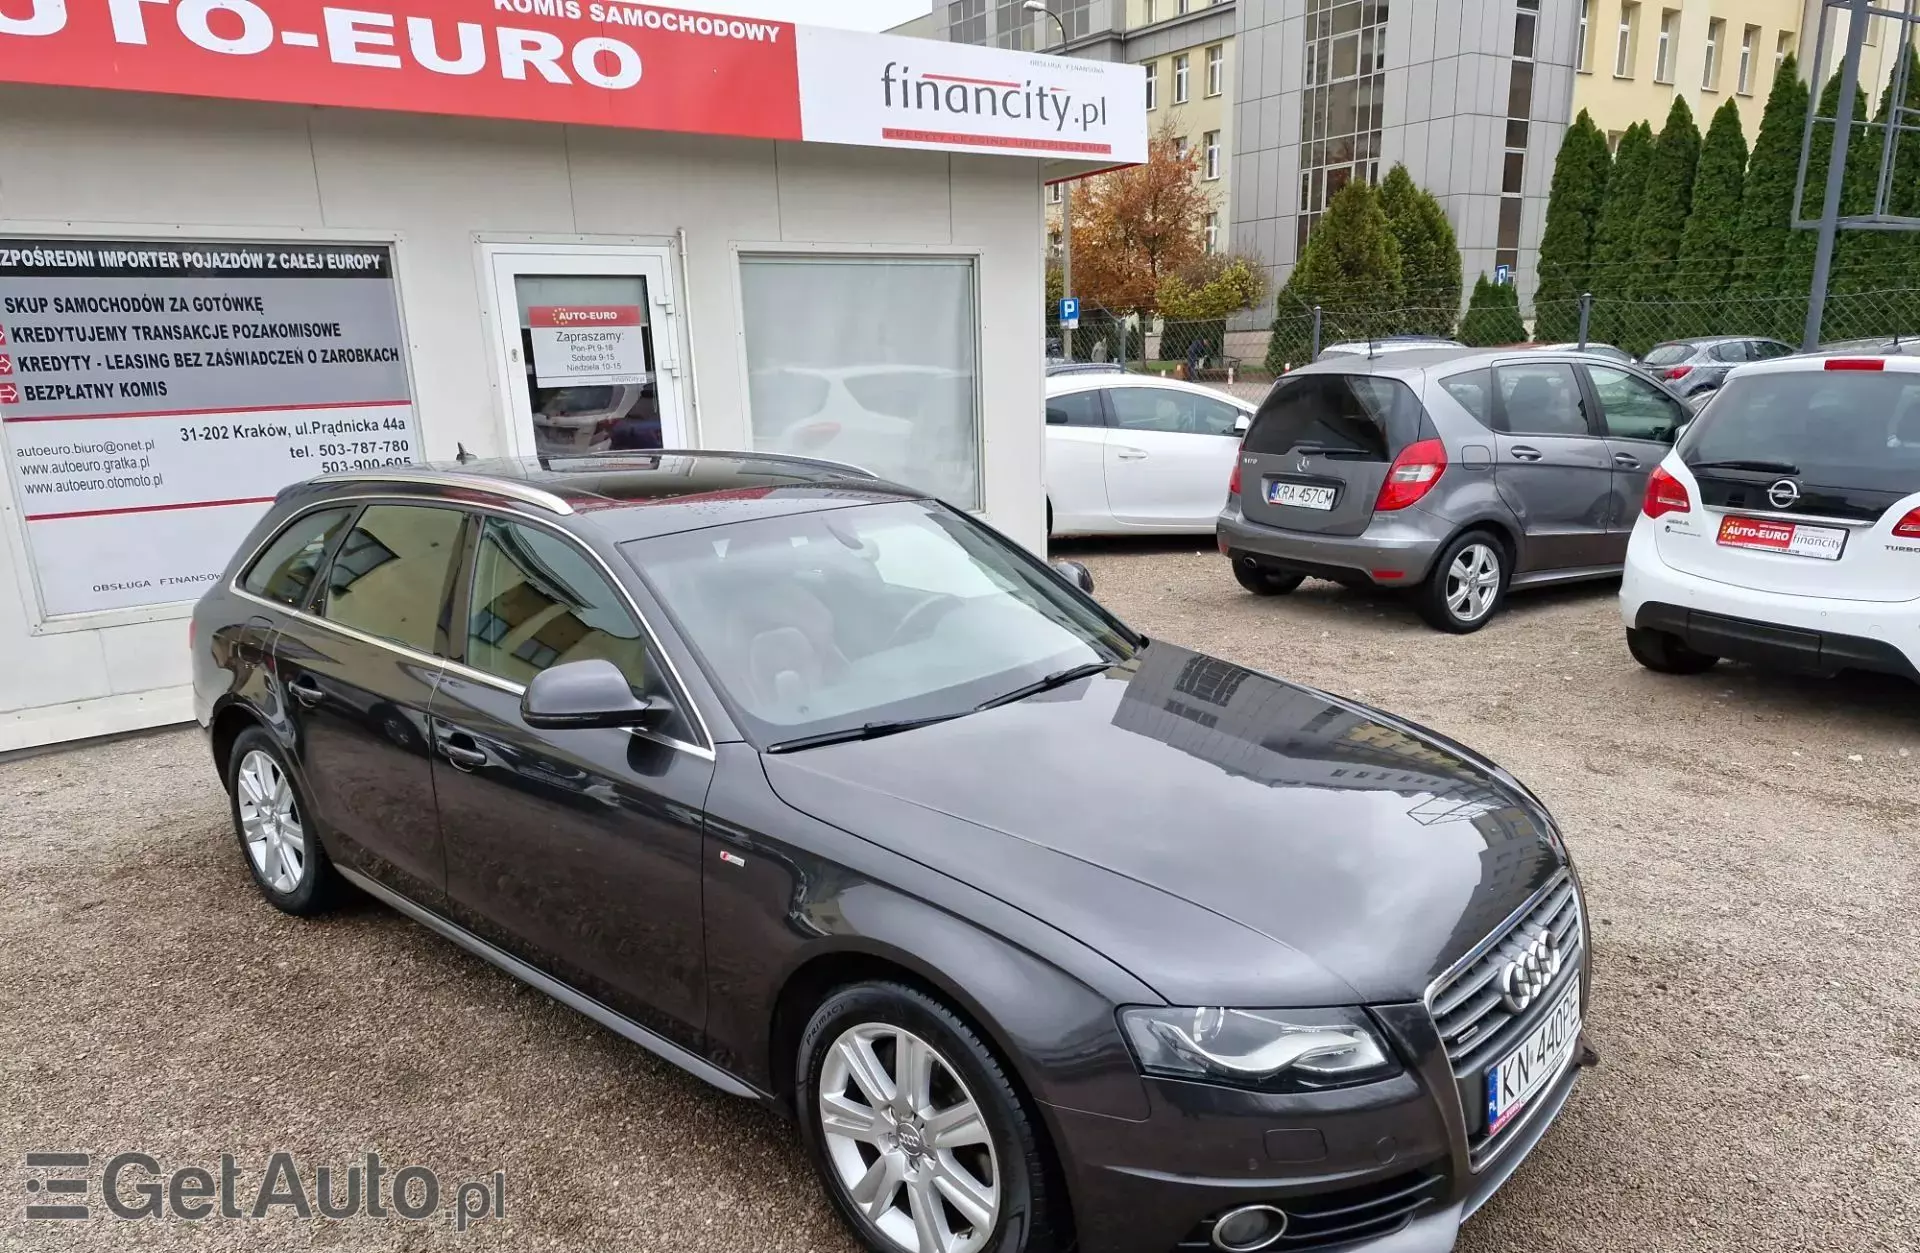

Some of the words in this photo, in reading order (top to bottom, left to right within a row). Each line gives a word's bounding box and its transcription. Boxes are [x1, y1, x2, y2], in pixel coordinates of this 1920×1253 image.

[494, 0, 582, 20] KOMIS
[588, 3, 780, 43] SAMOCHODOWY
[880, 61, 1106, 132] financity.pl
[98, 250, 180, 268] IMPORTER
[182, 249, 264, 270] POJAZDÓW
[266, 252, 278, 269] Z
[279, 251, 324, 269] CAŁEJ
[326, 253, 381, 270] EUROPY
[5, 297, 49, 314] SKUP
[54, 292, 165, 313] SAMOCHODÓW
[169, 297, 190, 312] ZA
[193, 292, 265, 315] GOTÓWKĘ
[1064, 300, 1075, 318] P
[558, 311, 618, 321] AUTO-EURO
[10, 325, 128, 343] KREDYTUJEMY
[131, 323, 229, 341] TRANSAKCJE
[232, 322, 342, 340] POZAKOMISOWE
[17, 355, 92, 373] KREDYTY
[105, 352, 171, 371] LEASING
[173, 352, 203, 368] BEZ
[205, 346, 305, 367] ZAŚWIADCZEŃ
[307, 349, 318, 364] O
[320, 347, 400, 364] ZAROBKACH
[571, 354, 597, 362] Sobota
[598, 353, 615, 361] 9-15
[24, 382, 115, 401] BEZPŁATNY
[118, 380, 169, 399] KOMIS
[179, 425, 230, 442] 31-202
[232, 423, 292, 438] Kraków,
[294, 418, 380, 436] ul.Prądnicka
[382, 417, 406, 431] 44a
[16, 439, 155, 458] autoeuro.biuro@onet.pl
[289, 446, 315, 459] tel.
[318, 439, 410, 458] 503-787-780
[19, 455, 151, 476] www.autoeuro.gratka.pl
[321, 456, 412, 474] 503-900-605
[24, 473, 164, 495] www.autoeuro.otomoto.pl
[1276, 484, 1296, 501] KRA
[1298, 487, 1334, 506] 457CM
[1726, 525, 1790, 541] AUTO-EURO
[92, 579, 152, 593] OBSŁUGA
[159, 572, 223, 585] FINANSOW
[1502, 1043, 1530, 1106] KN
[1536, 982, 1578, 1067] 440PE
